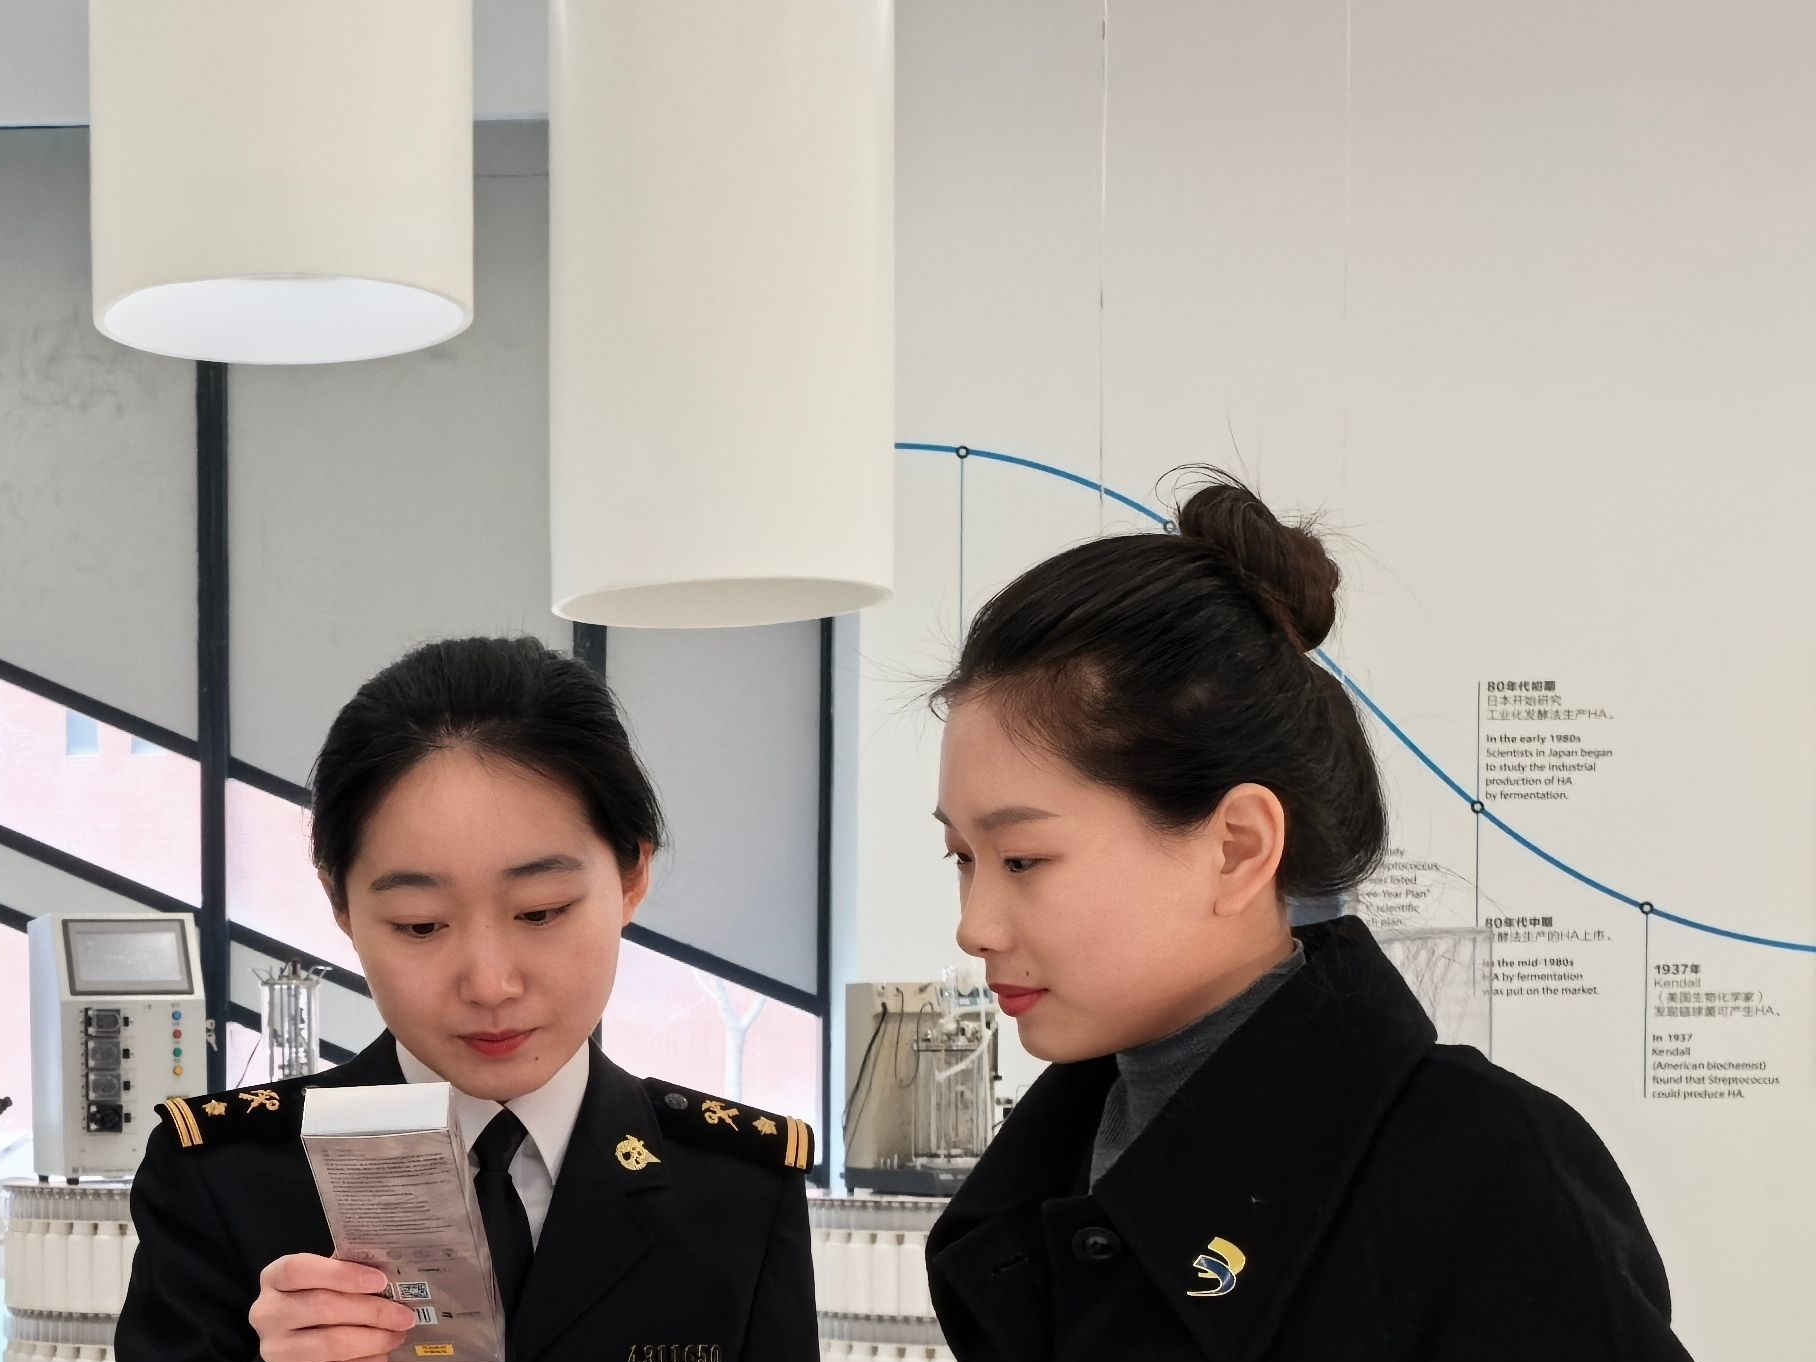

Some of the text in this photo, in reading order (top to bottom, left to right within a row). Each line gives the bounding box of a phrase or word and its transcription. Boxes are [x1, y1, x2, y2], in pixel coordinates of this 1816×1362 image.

[1486, 732, 1581, 745] In the early 1980s
[1486, 748, 1613, 760] Scientists in Japan began
[1499, 762, 1526, 773] study
[1529, 762, 1545, 772] the
[1548, 761, 1596, 772] industrial
[1485, 776, 1542, 787] production
[1544, 775, 1554, 786] of
[1485, 790, 1497, 801] by
[1497, 958, 1515, 968] the
[1654, 964, 1701, 976] 1937年
[1502, 972, 1515, 983] by
[1517, 972, 1584, 981] fermentation
[1654, 978, 1701, 989] Kendall
[1506, 986, 1523, 997] put
[1526, 986, 1539, 996] on
[1542, 985, 1559, 996] the
[1652, 1032, 1693, 1043] In 1937
[1651, 1047, 1691, 1057] Kendall
[1652, 1061, 1767, 1071] (American biochemist)
[1652, 1075, 1780, 1086] found that Streptococcus
[1652, 1089, 1681, 1099] could
[1683, 1089, 1725, 1101] produce
